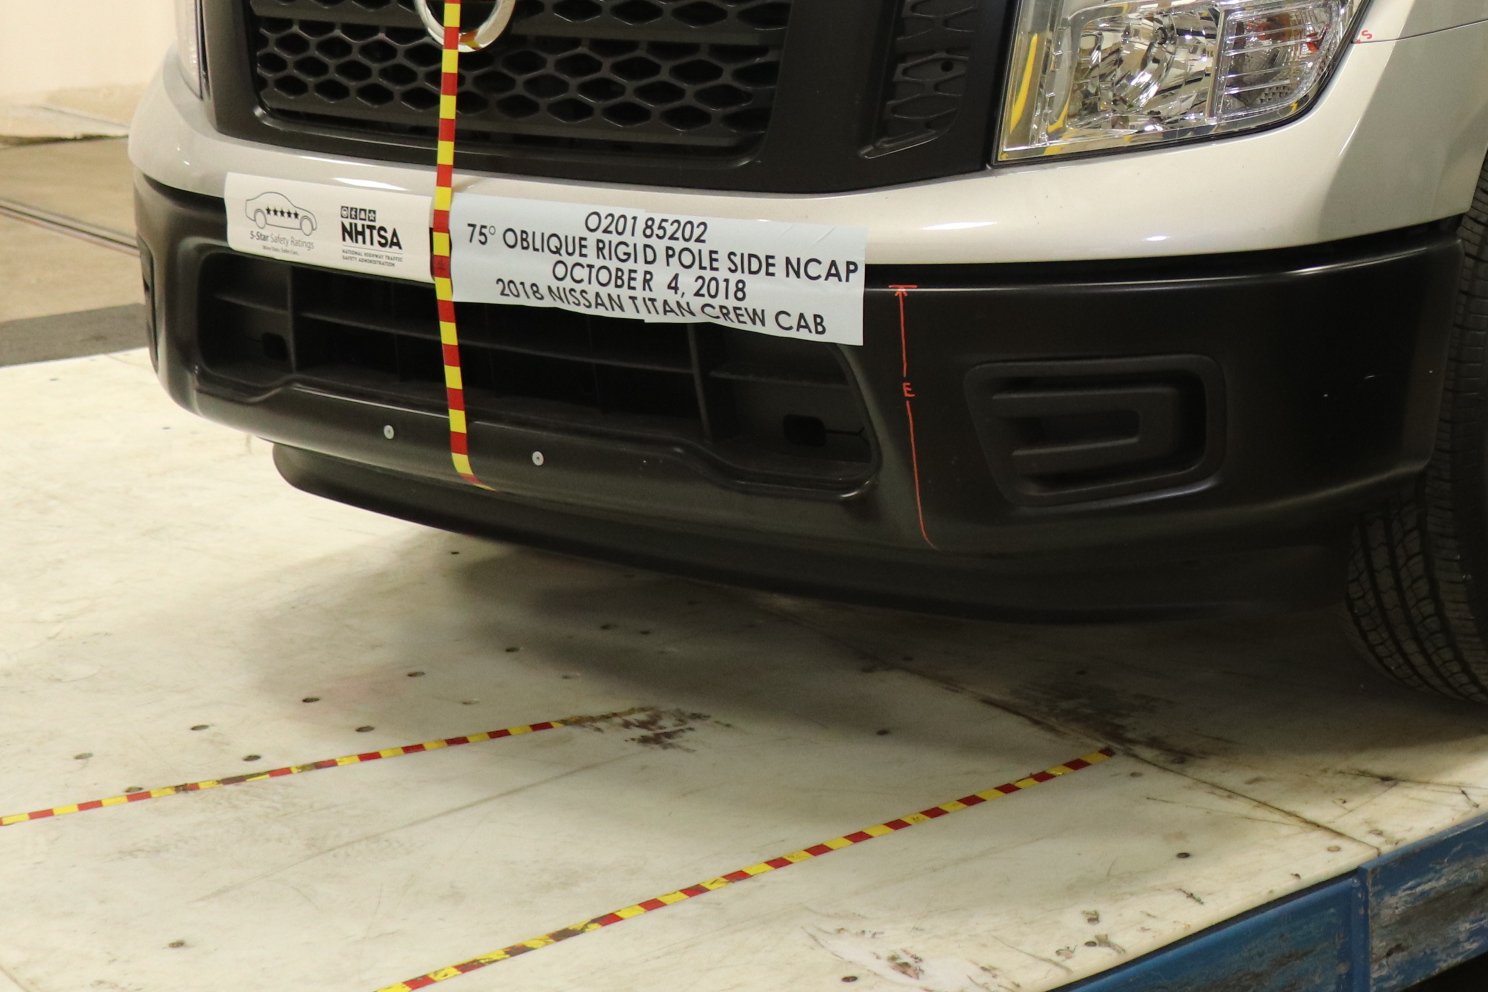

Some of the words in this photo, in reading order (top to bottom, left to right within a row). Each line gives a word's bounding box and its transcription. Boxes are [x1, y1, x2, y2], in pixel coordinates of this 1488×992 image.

[250, 230, 269, 241] 5-Star
[270, 233, 289, 247] Safety
[290, 236, 315, 251] Ratings
[341, 220, 403, 250] NHTSA
[342, 249, 363, 257] NATIONAL
[503, 228, 588, 259] OBLIQUE
[596, 238, 657, 265] RIGID
[665, 246, 719, 272] POLE
[727, 251, 776, 277] SIDE
[785, 256, 859, 283] NCAP
[552, 260, 654, 293] OCTOBER
[666, 273, 685, 299] 4,
[693, 275, 747, 302] 2018
[496, 278, 545, 300] 2018
[547, 285, 625, 313] NISSAN
[628, 295, 697, 317] TITAN
[701, 303, 766, 327] CREW
[774, 310, 827, 335] CAB
[903, 382, 916, 397] E
